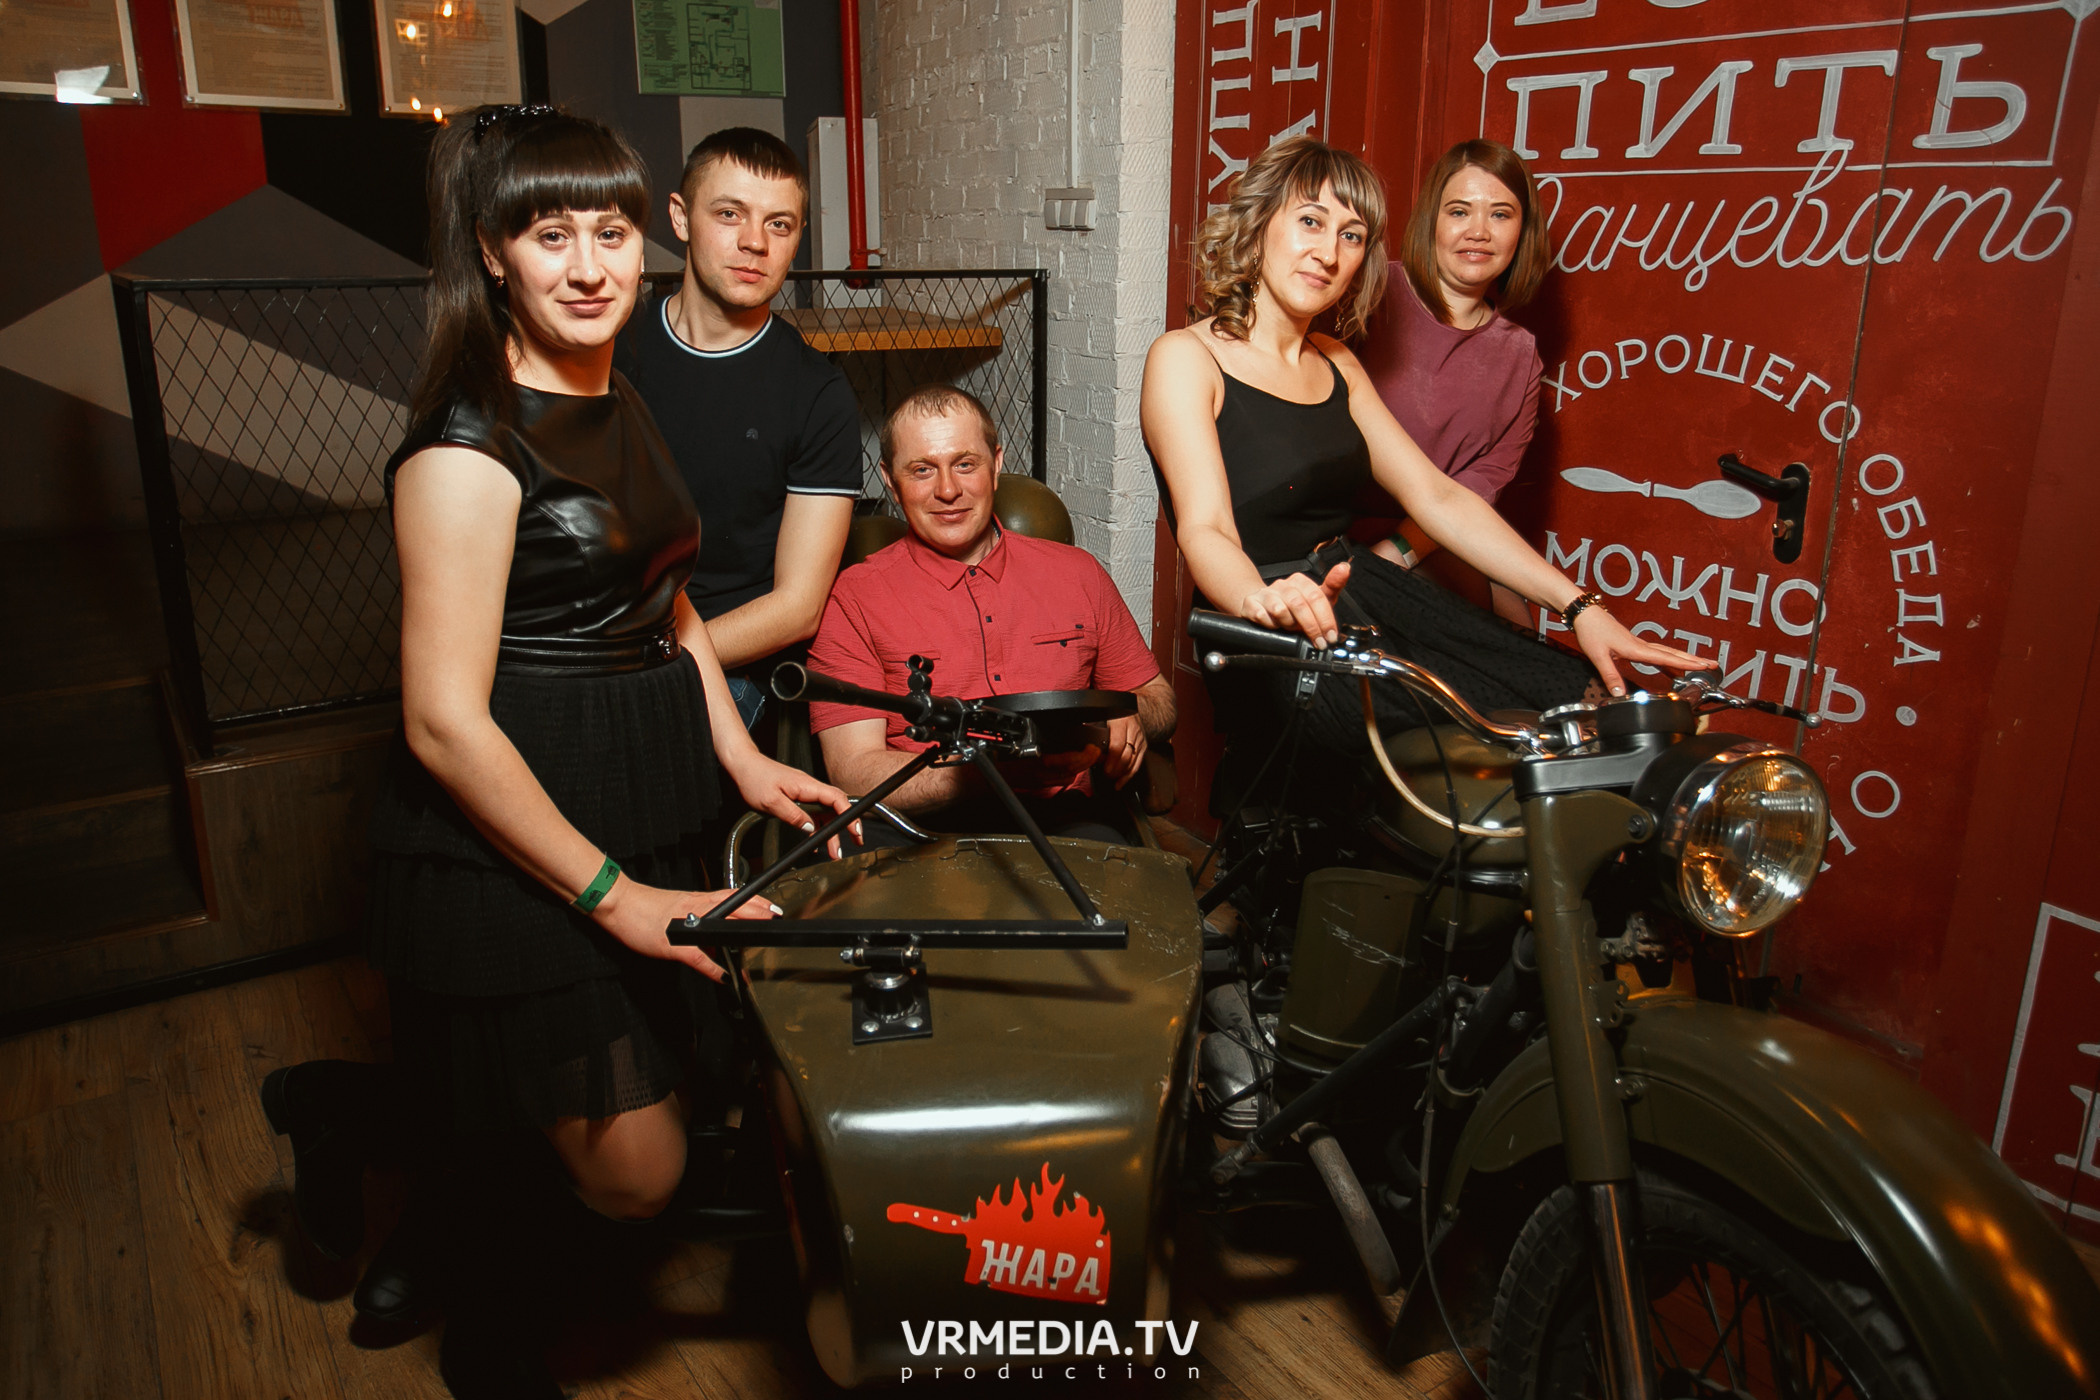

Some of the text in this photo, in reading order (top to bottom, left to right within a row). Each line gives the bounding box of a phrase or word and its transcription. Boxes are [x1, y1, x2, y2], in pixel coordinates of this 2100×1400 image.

[1206, 0, 1256, 222] УПЦ
[1506, 43, 2027, 160] ПИТЬ
[1541, 334, 1944, 667] ХОРОШЕГО ОБЕДА
[1545, 530, 1827, 637] МОЖНО
[980, 1239, 1101, 1296] ЖАРА
